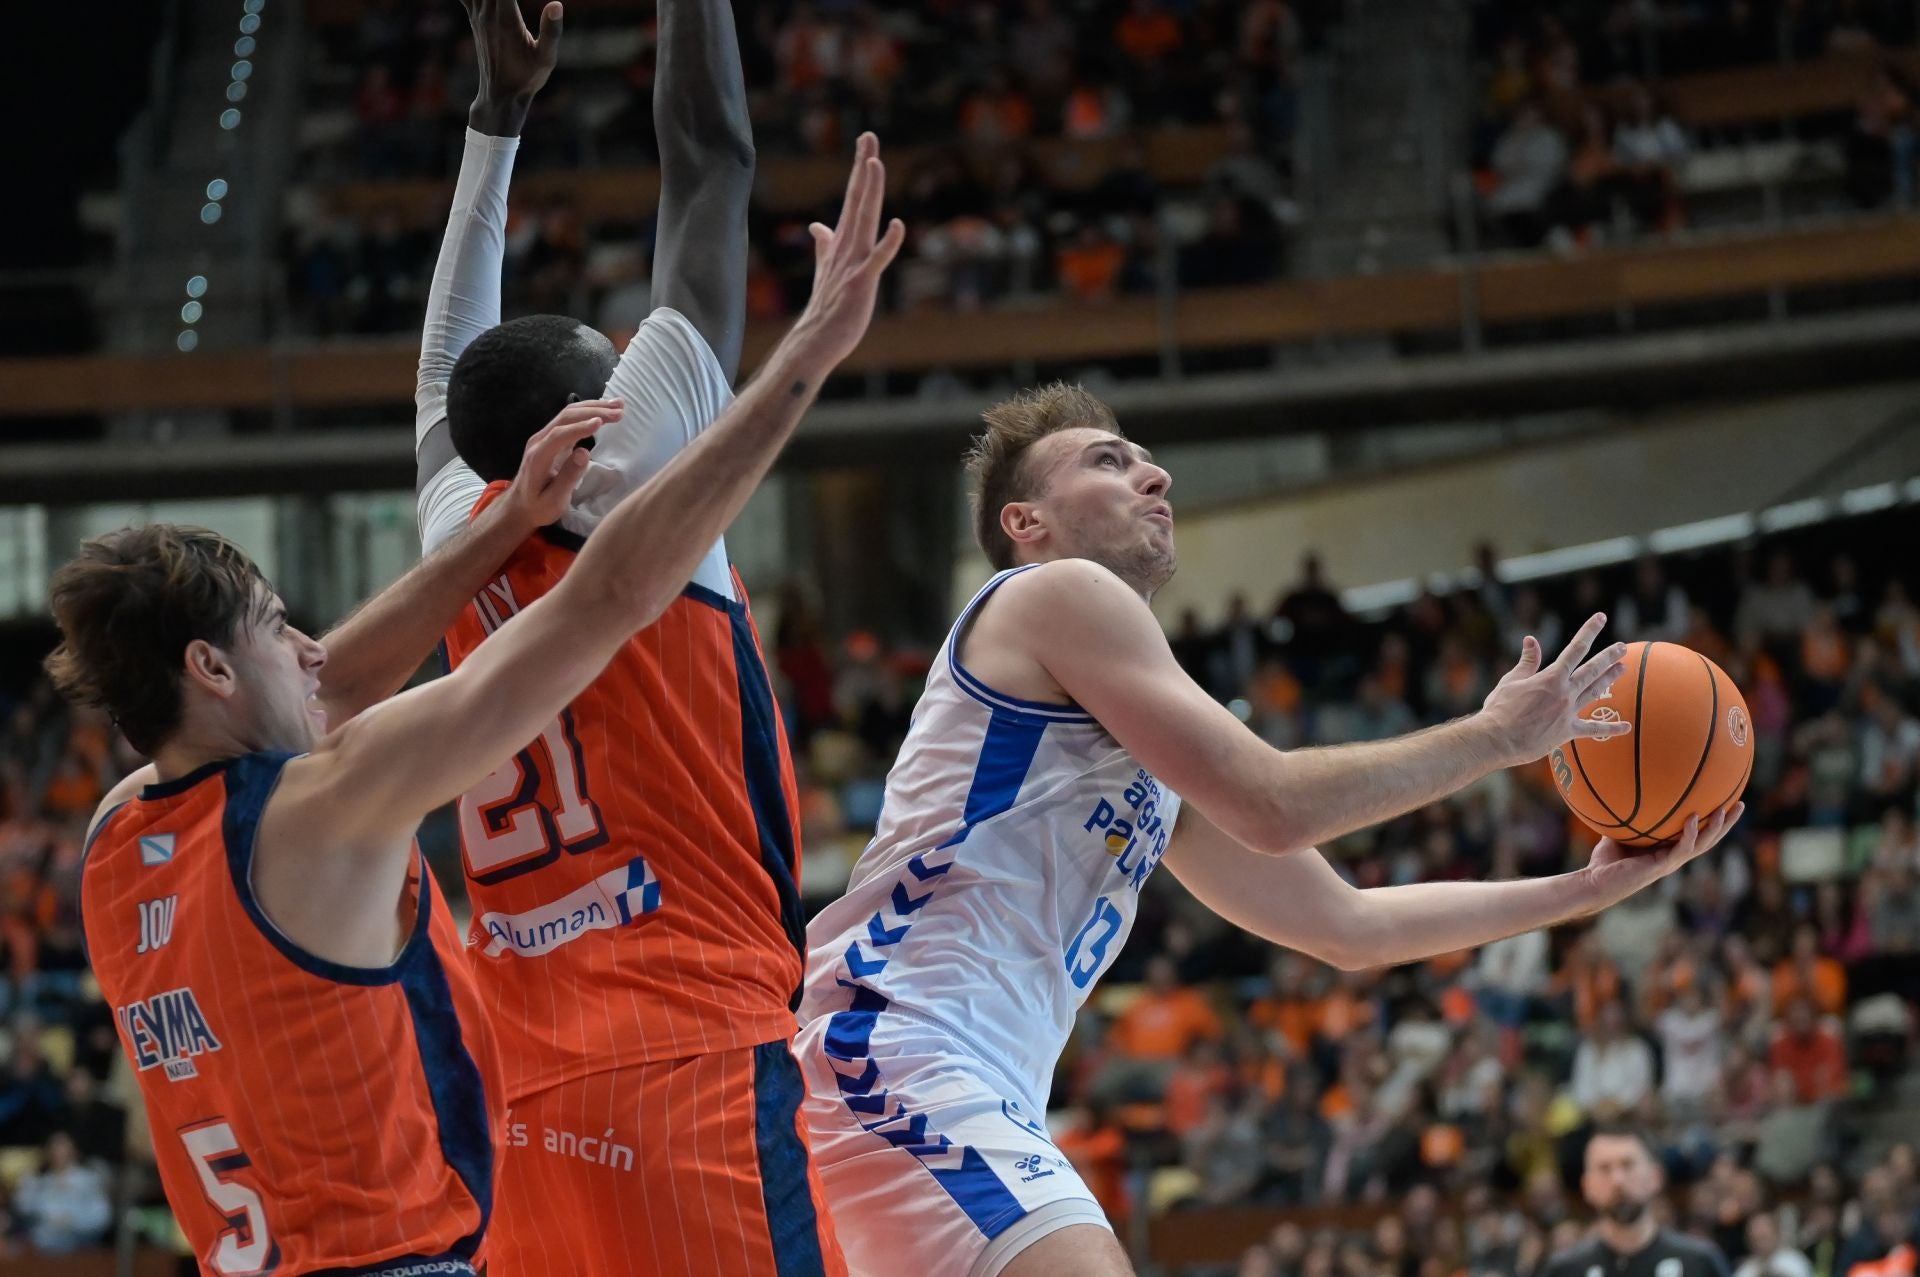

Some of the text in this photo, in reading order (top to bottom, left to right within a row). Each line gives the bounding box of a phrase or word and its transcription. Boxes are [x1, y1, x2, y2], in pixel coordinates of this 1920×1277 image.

[459, 708, 604, 880] 21
[136, 894, 178, 954] JOU
[488, 901, 606, 949] Aluman
[1064, 896, 1123, 990] 13
[543, 1127, 634, 1172] ancín
[179, 1119, 274, 1275] 5
